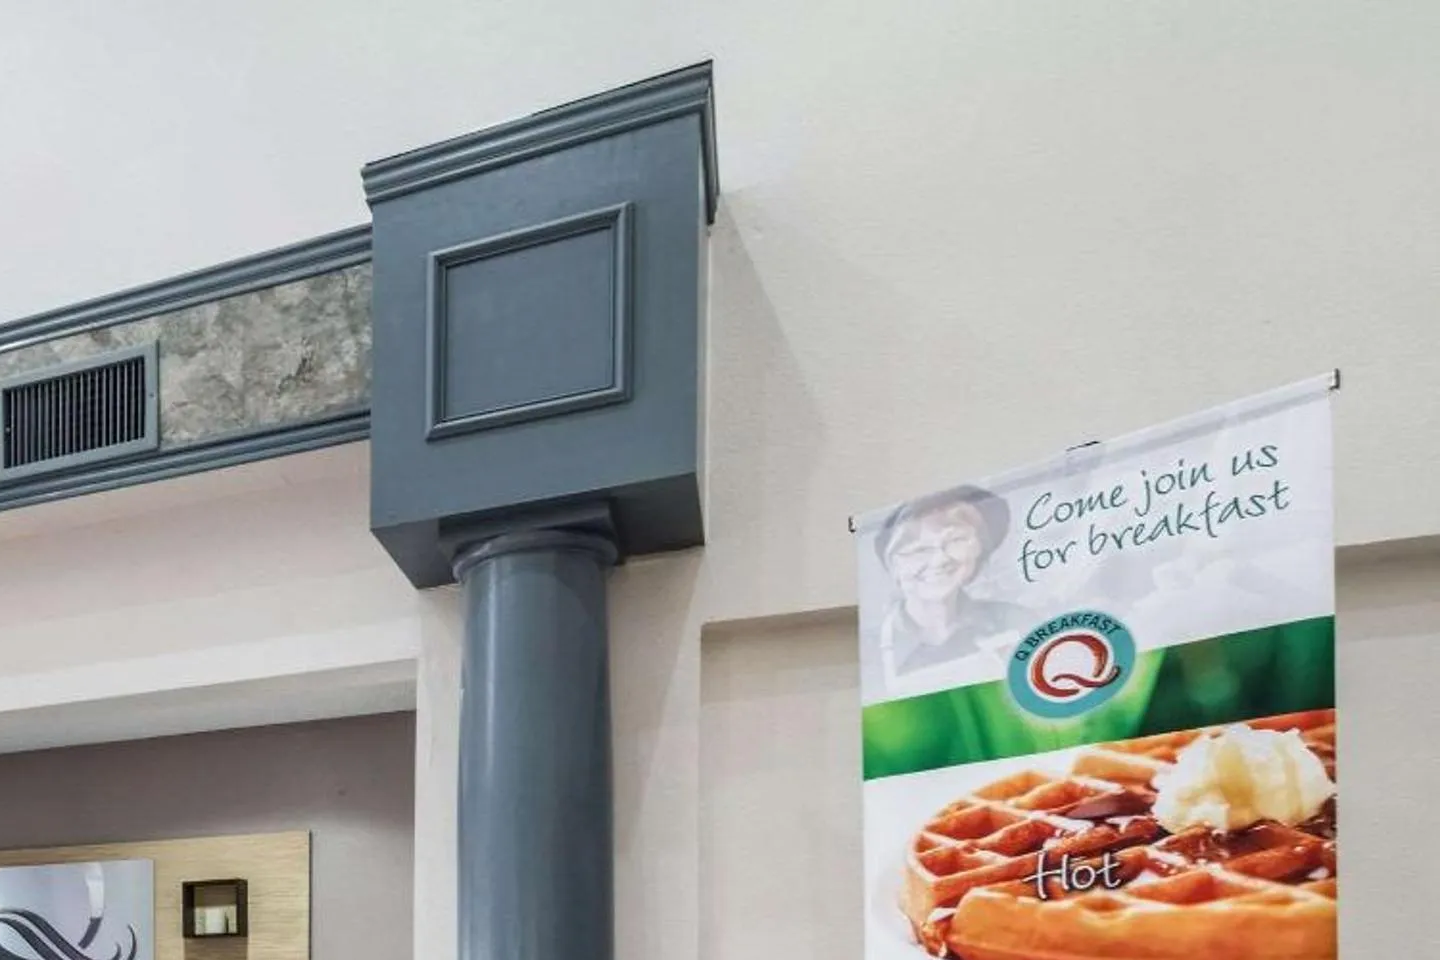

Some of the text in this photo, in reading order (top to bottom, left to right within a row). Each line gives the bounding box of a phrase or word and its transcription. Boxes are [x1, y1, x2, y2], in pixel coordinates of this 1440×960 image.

[1025, 444, 1279, 530] Come join us
[1017, 480, 1290, 582] for breakfast
[1015, 613, 1122, 661] Q BREAKFAST
[1022, 849, 1121, 900] Hot
